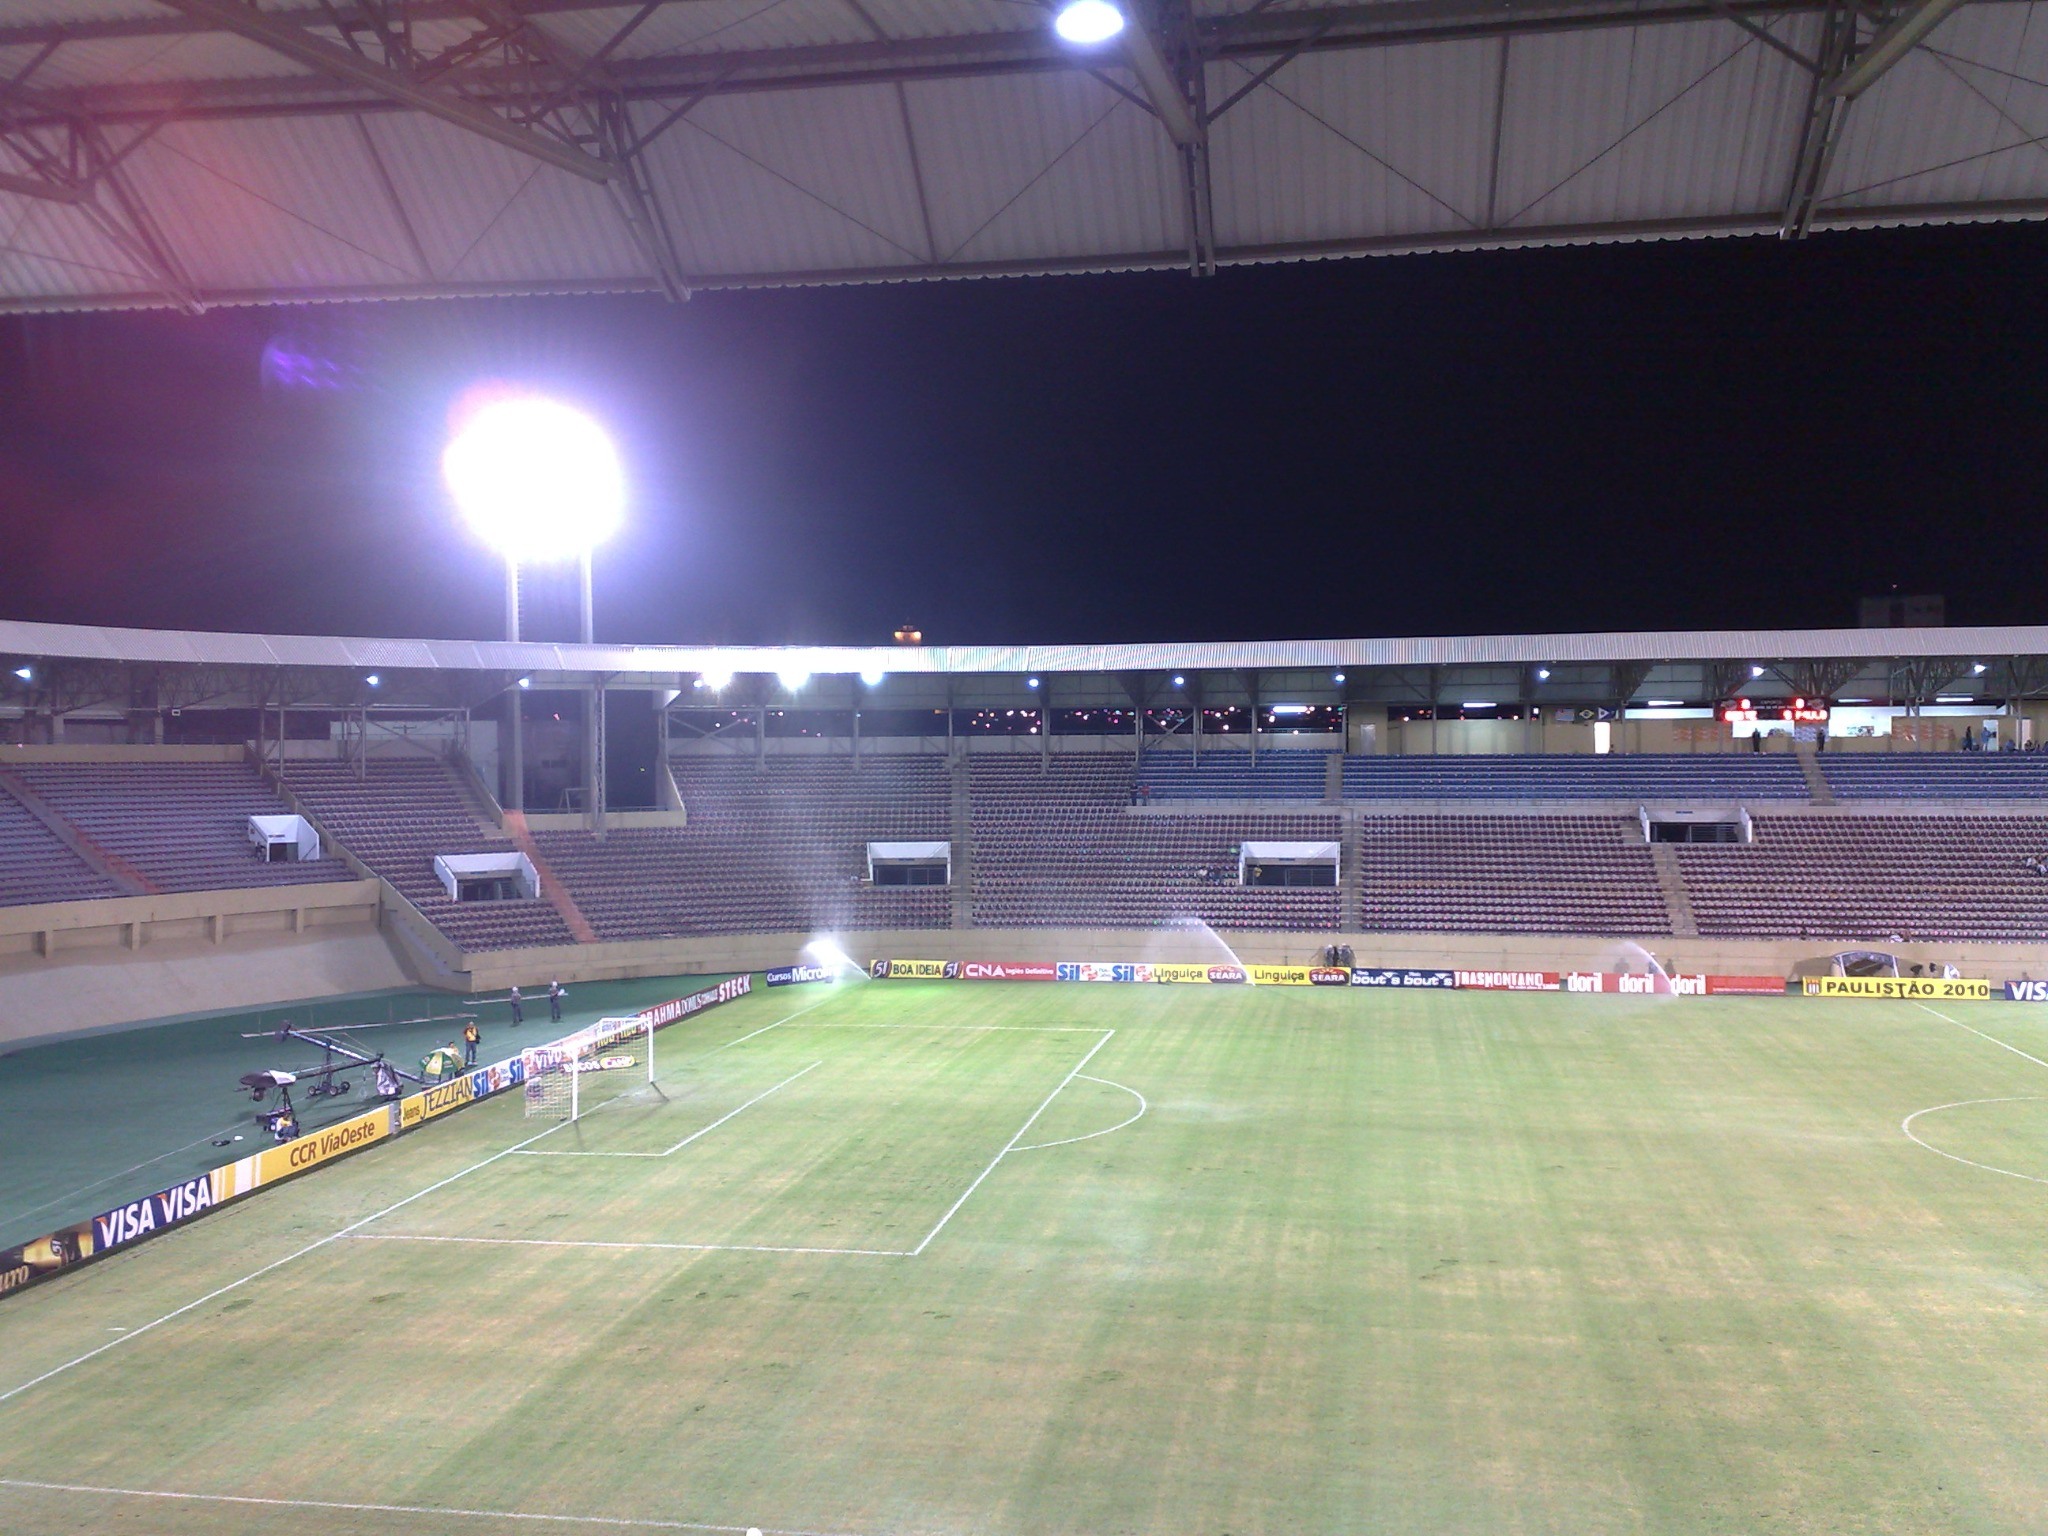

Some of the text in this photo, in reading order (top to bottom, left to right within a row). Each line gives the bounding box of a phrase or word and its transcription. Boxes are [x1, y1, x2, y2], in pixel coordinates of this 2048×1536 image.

[766, 972, 791, 982] Cursos
[874, 960, 888, 978] 51
[893, 962, 942, 976] BOA IDEIA
[946, 961, 958, 977] 51
[965, 963, 1005, 977] CNA
[1058, 964, 1081, 981] Sil
[1111, 965, 1135, 982] Sil
[1154, 967, 1245, 982] Linguiça SEARA
[1254, 969, 1305, 984] Linguiça
[1311, 973, 1346, 983] SEARA
[718, 973, 751, 1003] STECK
[1453, 971, 1544, 987] TRASMONTANO
[1567, 971, 1603, 992] doril
[1618, 972, 1655, 993] doril
[1671, 973, 1707, 994] doril
[1826, 979, 1988, 997] PAULISTÃO 2010
[508, 1057, 525, 1084] Sil
[473, 1069, 489, 1098] Sil
[420, 1075, 474, 1121] JEZZIAN
[289, 1120, 376, 1168] CCR ViaOeste
[158, 1178, 211, 1224] VISA
[96, 1197, 156, 1248] VISA
